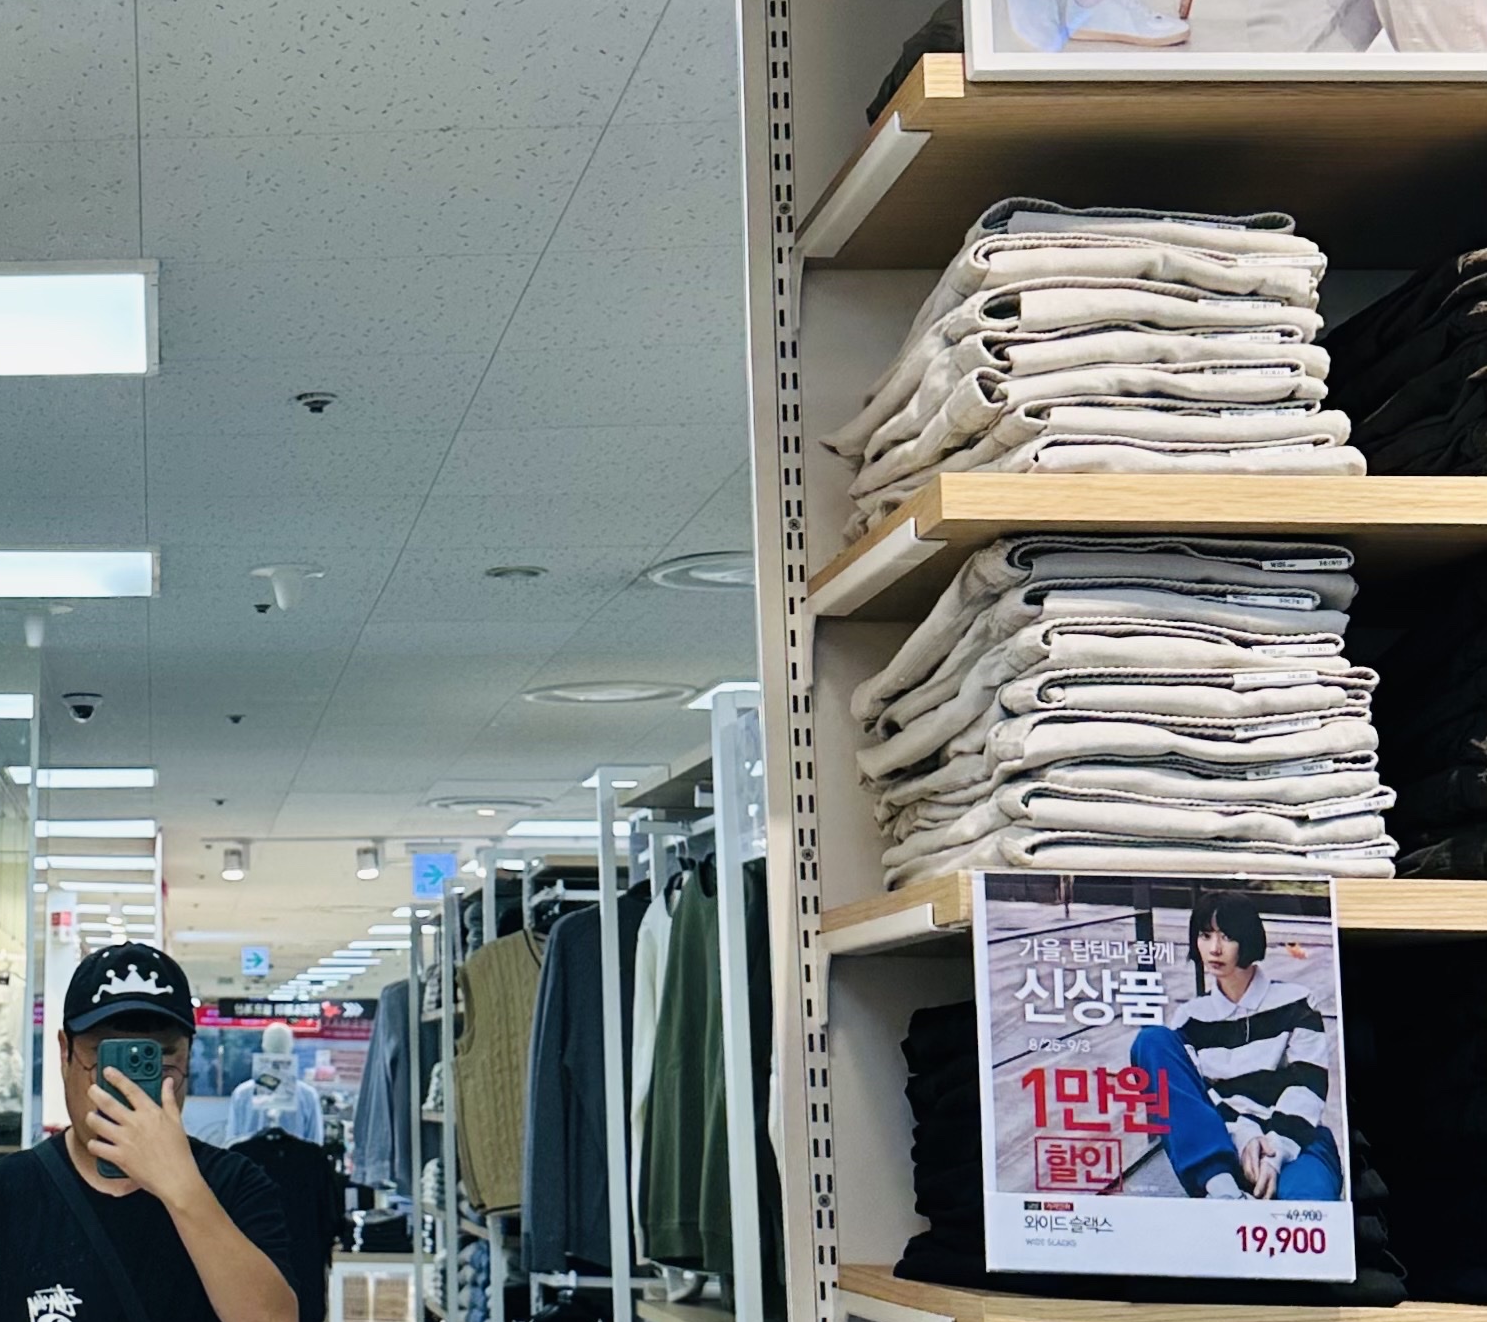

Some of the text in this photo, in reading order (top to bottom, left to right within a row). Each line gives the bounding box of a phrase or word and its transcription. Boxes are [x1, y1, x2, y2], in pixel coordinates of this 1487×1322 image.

[1019, 937, 1176, 966] 가을, 탑텐과 함께
[1014, 967, 1169, 1026] 신상품
[1021, 1066, 1171, 1135] 1만원
[1044, 1143, 1114, 1184] 할인
[1024, 1215, 1114, 1234] 와이드 슬랙스
[1236, 1225, 1326, 1258] 19,900
